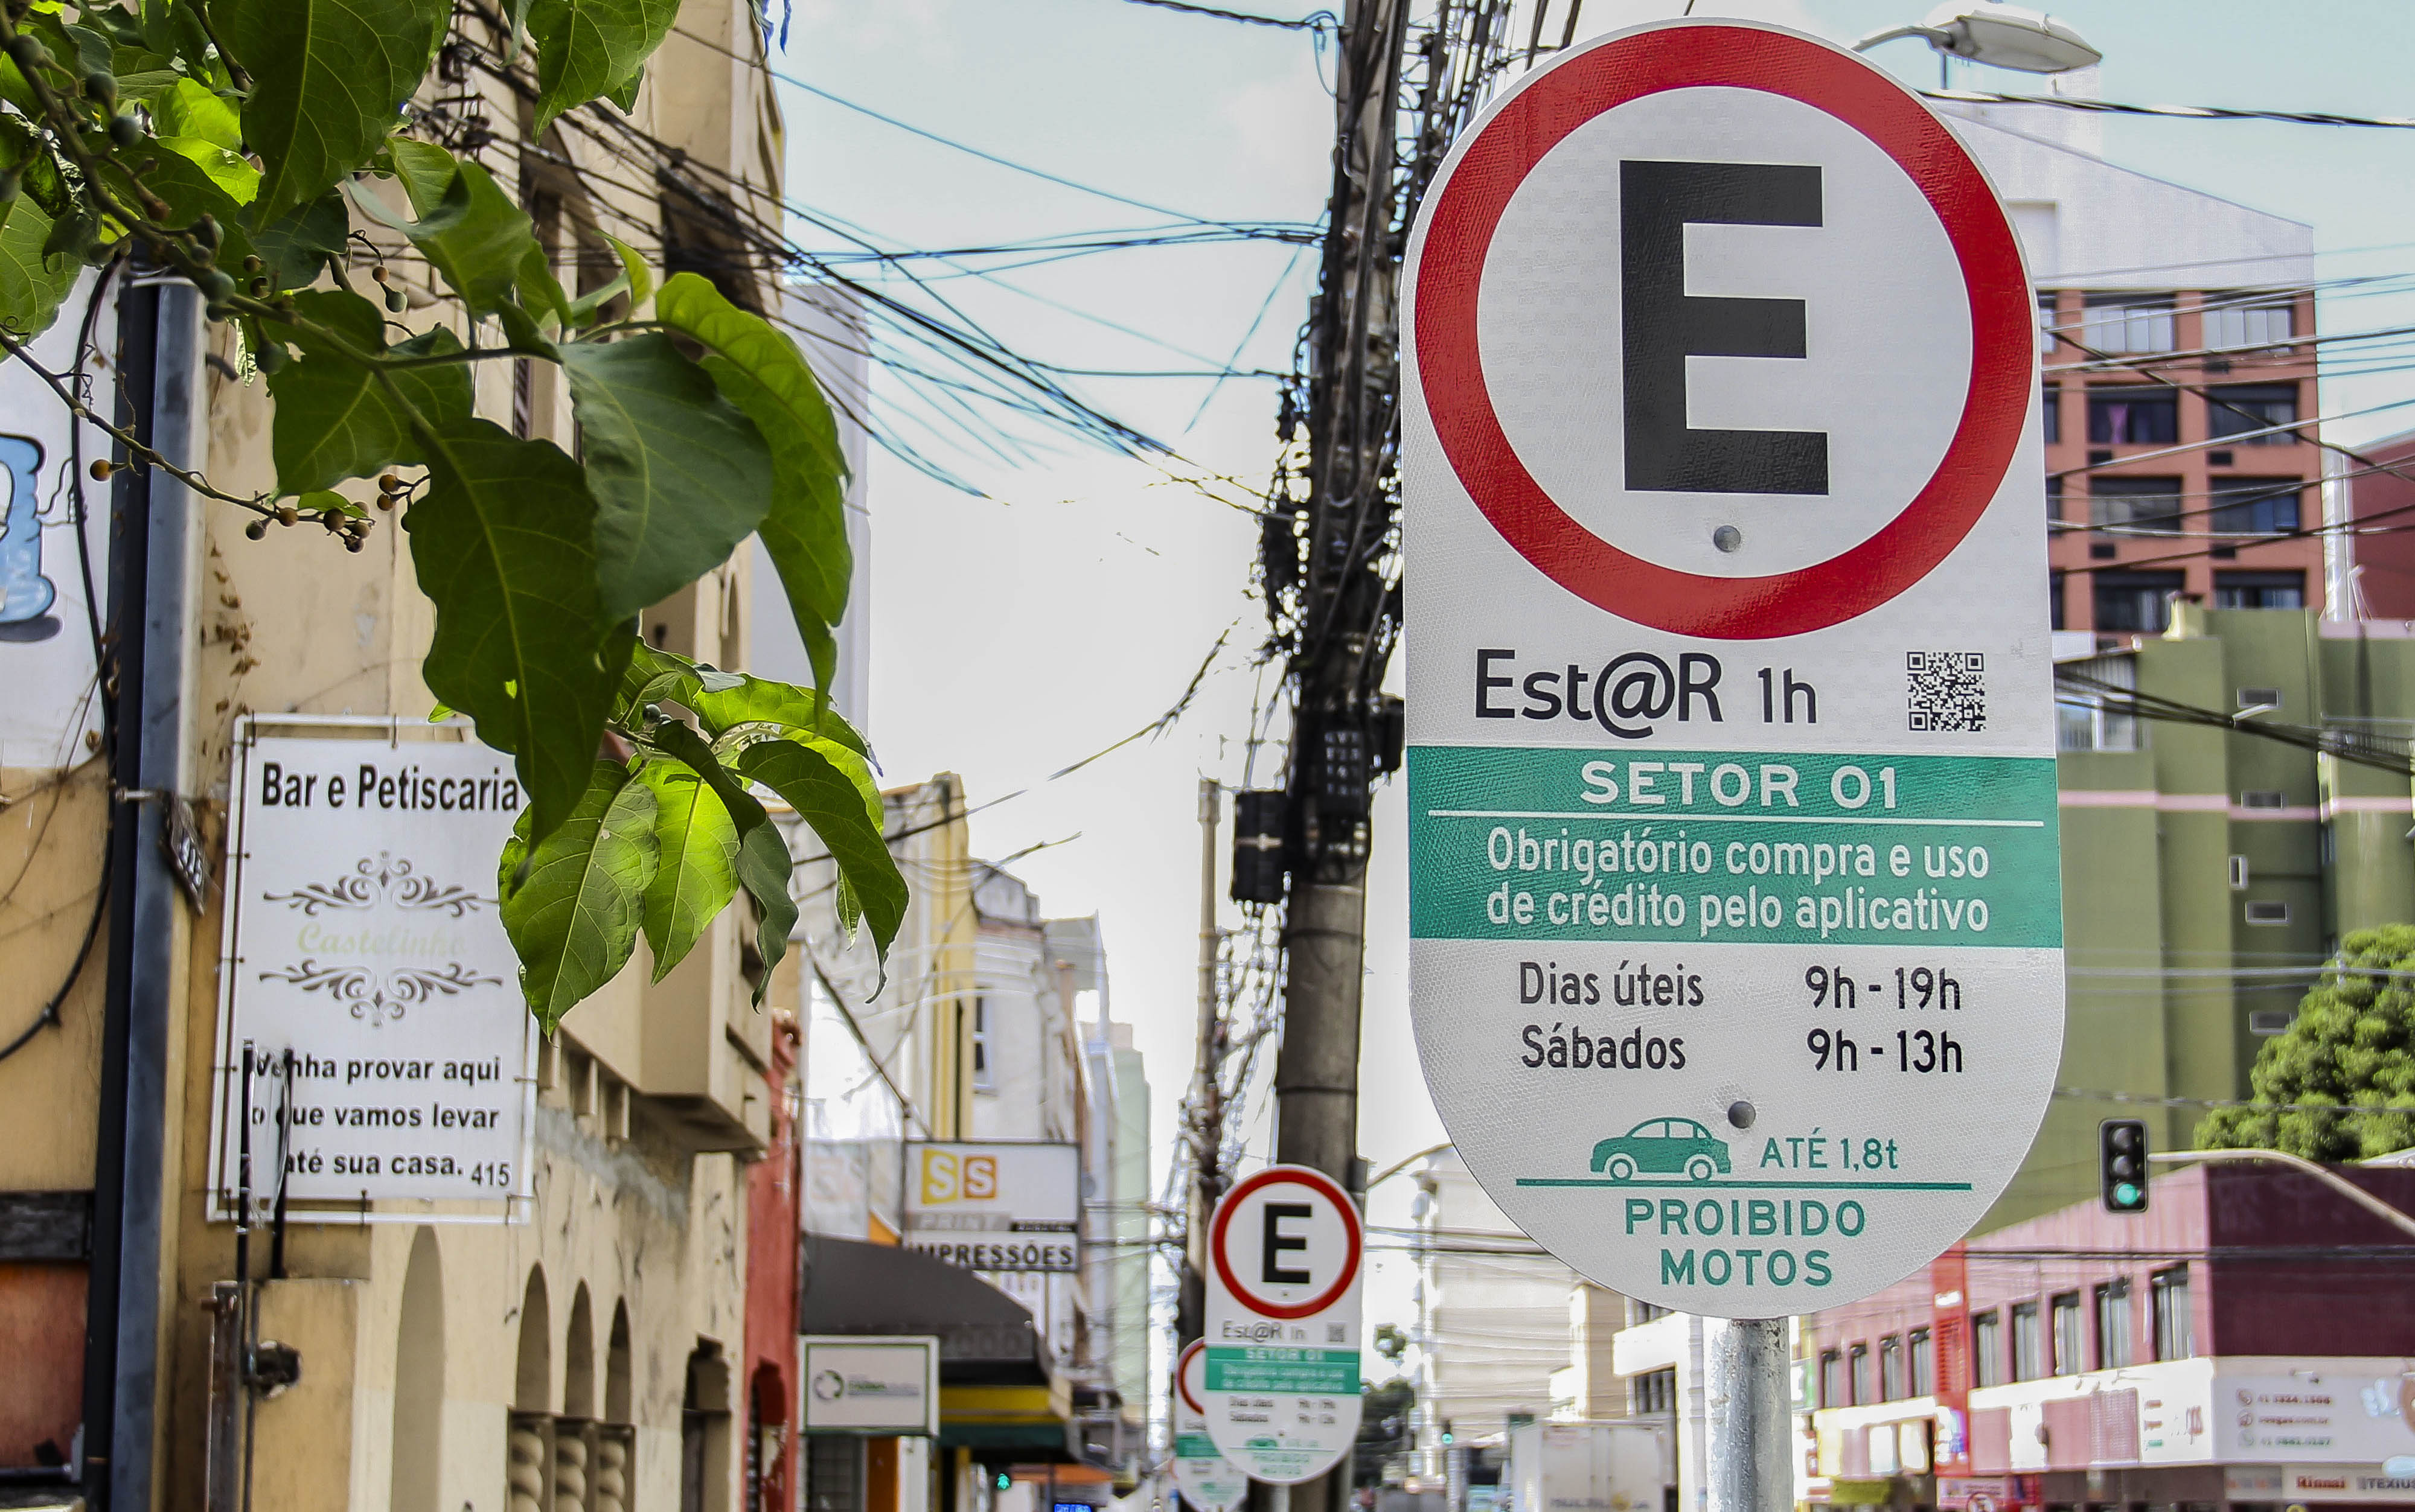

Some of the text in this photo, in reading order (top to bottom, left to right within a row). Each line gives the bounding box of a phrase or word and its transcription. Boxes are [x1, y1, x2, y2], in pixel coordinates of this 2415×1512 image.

[1620, 159, 1829, 495] E
[1474, 648, 1817, 739] Est@R 1h
[262, 761, 520, 811] Bar e Petiscaria
[1579, 761, 1898, 810] SETOR 01
[1487, 826, 1990, 886] Obrigatório compra e uso
[1486, 879, 1990, 939] de crédito pelo aplicativo
[298, 922, 469, 956] Castelinho
[1519, 960, 1600, 1006] Dias
[1613, 959, 1706, 1007] úteis
[1805, 966, 1856, 1010] 9h
[1895, 966, 1962, 1011] 19h
[347, 1060, 435, 1085] provar
[443, 1056, 500, 1086] aqui
[1520, 1021, 1687, 1071] Sábados
[1806, 1027, 1858, 1073] 9h
[1897, 1028, 1963, 1074] 13h
[252, 1105, 267, 1126] o
[334, 1108, 423, 1127] vamos
[432, 1102, 500, 1128] levar
[333, 1155, 380, 1174] sua
[392, 1155, 464, 1175] casa.
[1759, 1127, 1899, 1173] ATÉ 1,8t
[470, 1161, 512, 1187] 415
[1624, 1198, 1867, 1238] PROIBIDO
[909, 1239, 1073, 1265] PRESSÕES
[1261, 1204, 1313, 1284] E
[1660, 1248, 1834, 1287] MOTOS
